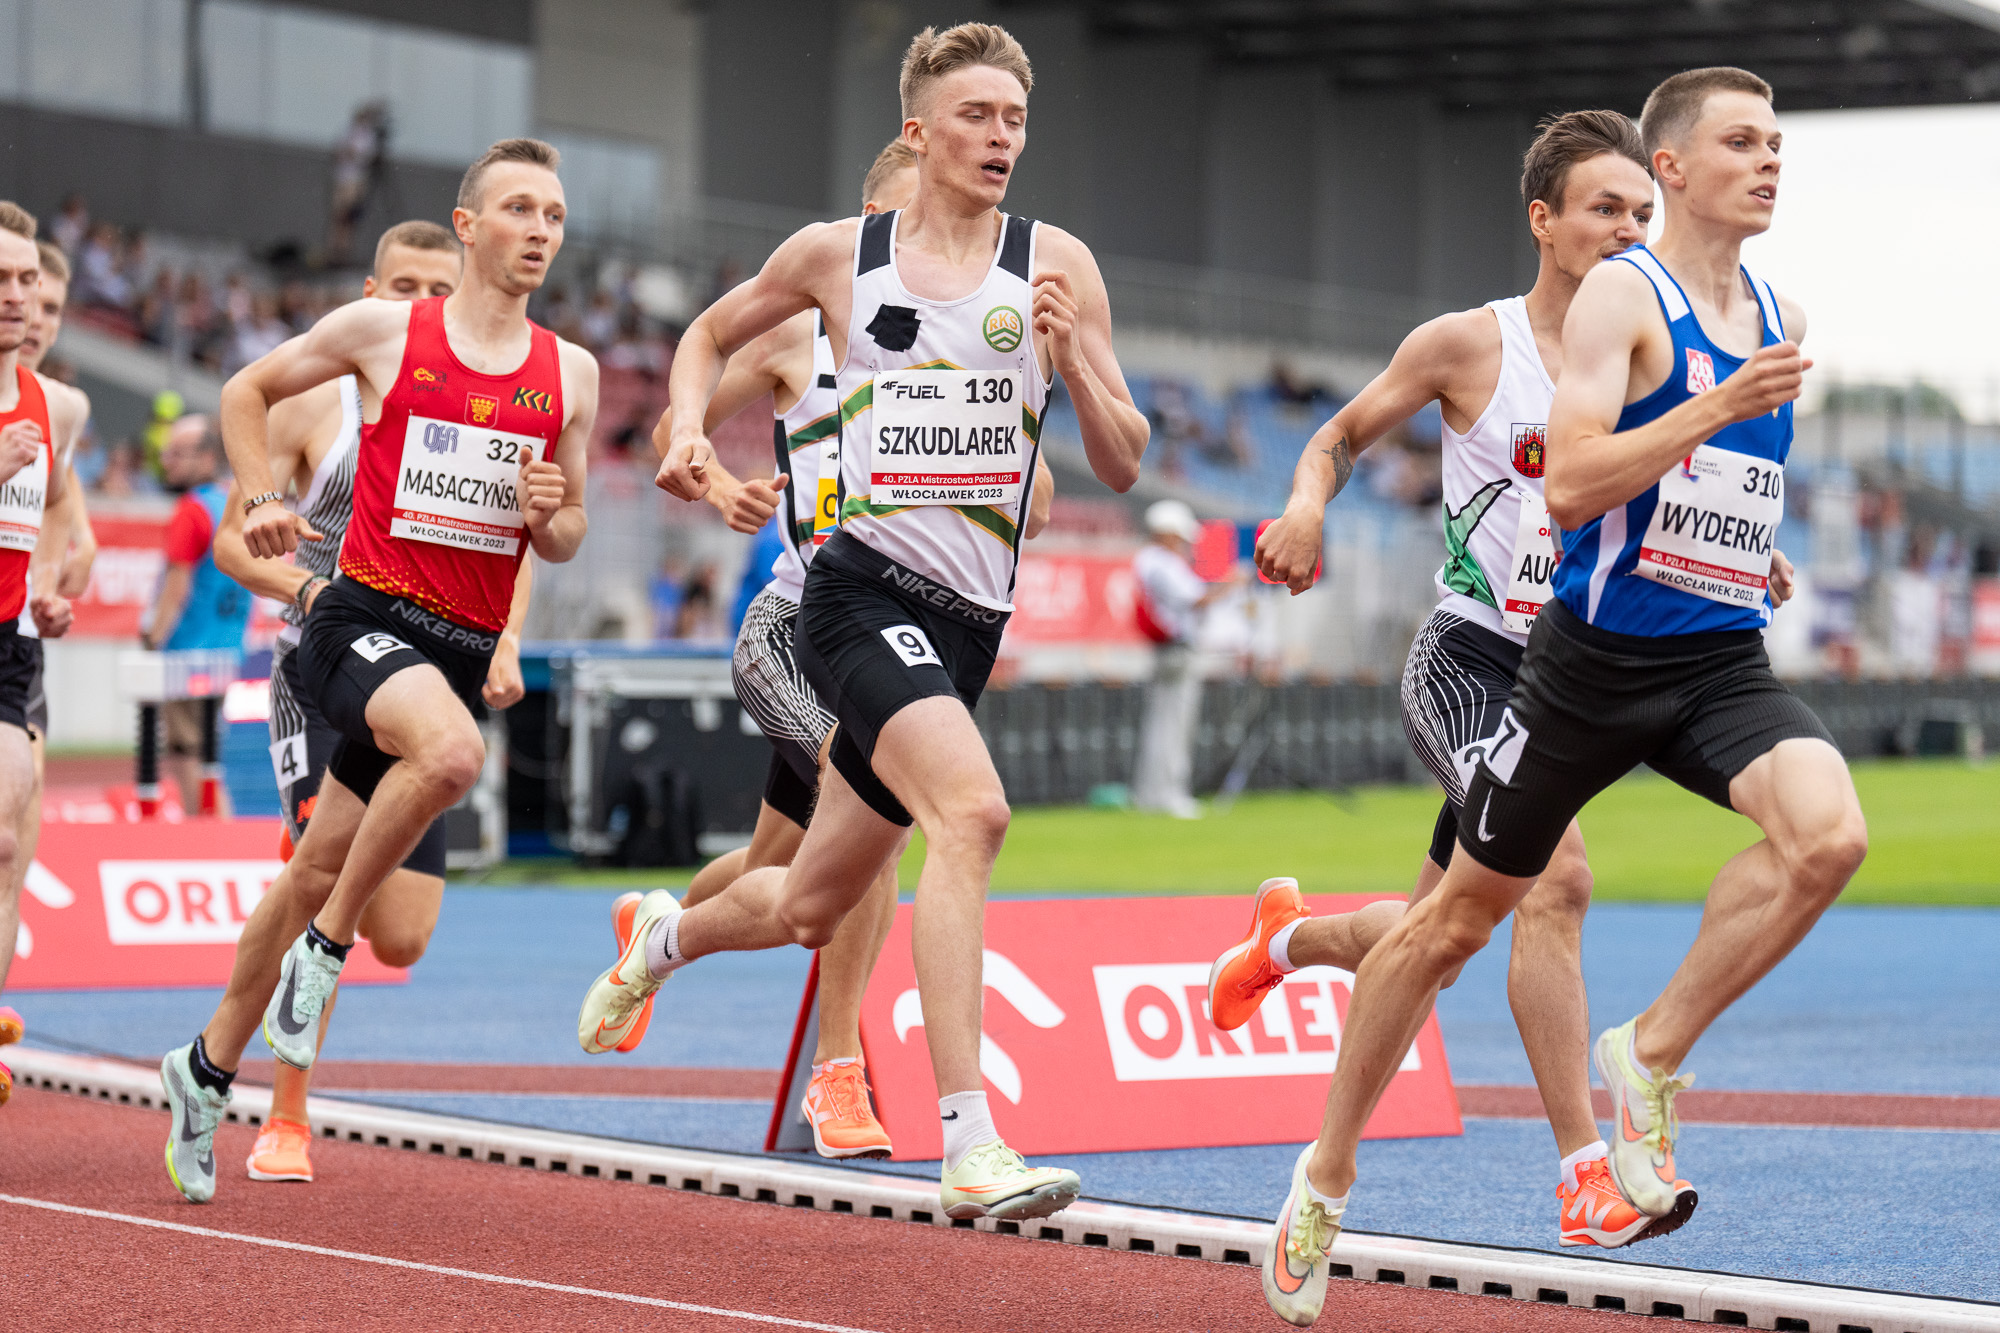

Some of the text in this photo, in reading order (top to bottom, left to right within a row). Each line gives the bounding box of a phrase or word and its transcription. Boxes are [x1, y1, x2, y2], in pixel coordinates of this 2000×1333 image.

[989, 312, 1018, 331] RKS
[896, 385, 946, 400] FUEL
[964, 377, 1013, 404] 130
[486, 438, 533, 465] 32
[878, 425, 1017, 456] SZKUDLAREK
[403, 467, 522, 513] MASACZYŃSK
[882, 474, 1013, 485] 40. PZLA Mistrzostwa Polski U23
[892, 488, 1003, 500] WŁOCŁAWEK 2023
[1743, 466, 1780, 500] 310
[0, 484, 42, 513] INIAK
[402, 511, 415, 520] 40.
[416, 512, 436, 525] PZLA
[437, 516, 483, 532] Mistrzostwa
[483, 523, 503, 536] Polski
[409, 525, 506, 549] WŁOCŁAWEK 2023
[1662, 501, 1773, 557] WYDERKA
[1650, 552, 1664, 563] 40.
[1665, 557, 1686, 570] PZLA
[1687, 561, 1733, 581] Mistrzostwa
[1734, 572, 1753, 585] Polski
[881, 564, 1001, 624] NIKE PRO
[1656, 569, 1753, 602] WŁOCŁAWEK 2023
[1516, 603, 1531, 613] 40.
[389, 599, 495, 651] NIKE PRO
[367, 635, 399, 652] 5
[1488, 715, 1518, 763] 7
[281, 741, 298, 777] 4
[124, 879, 276, 926] ORL
